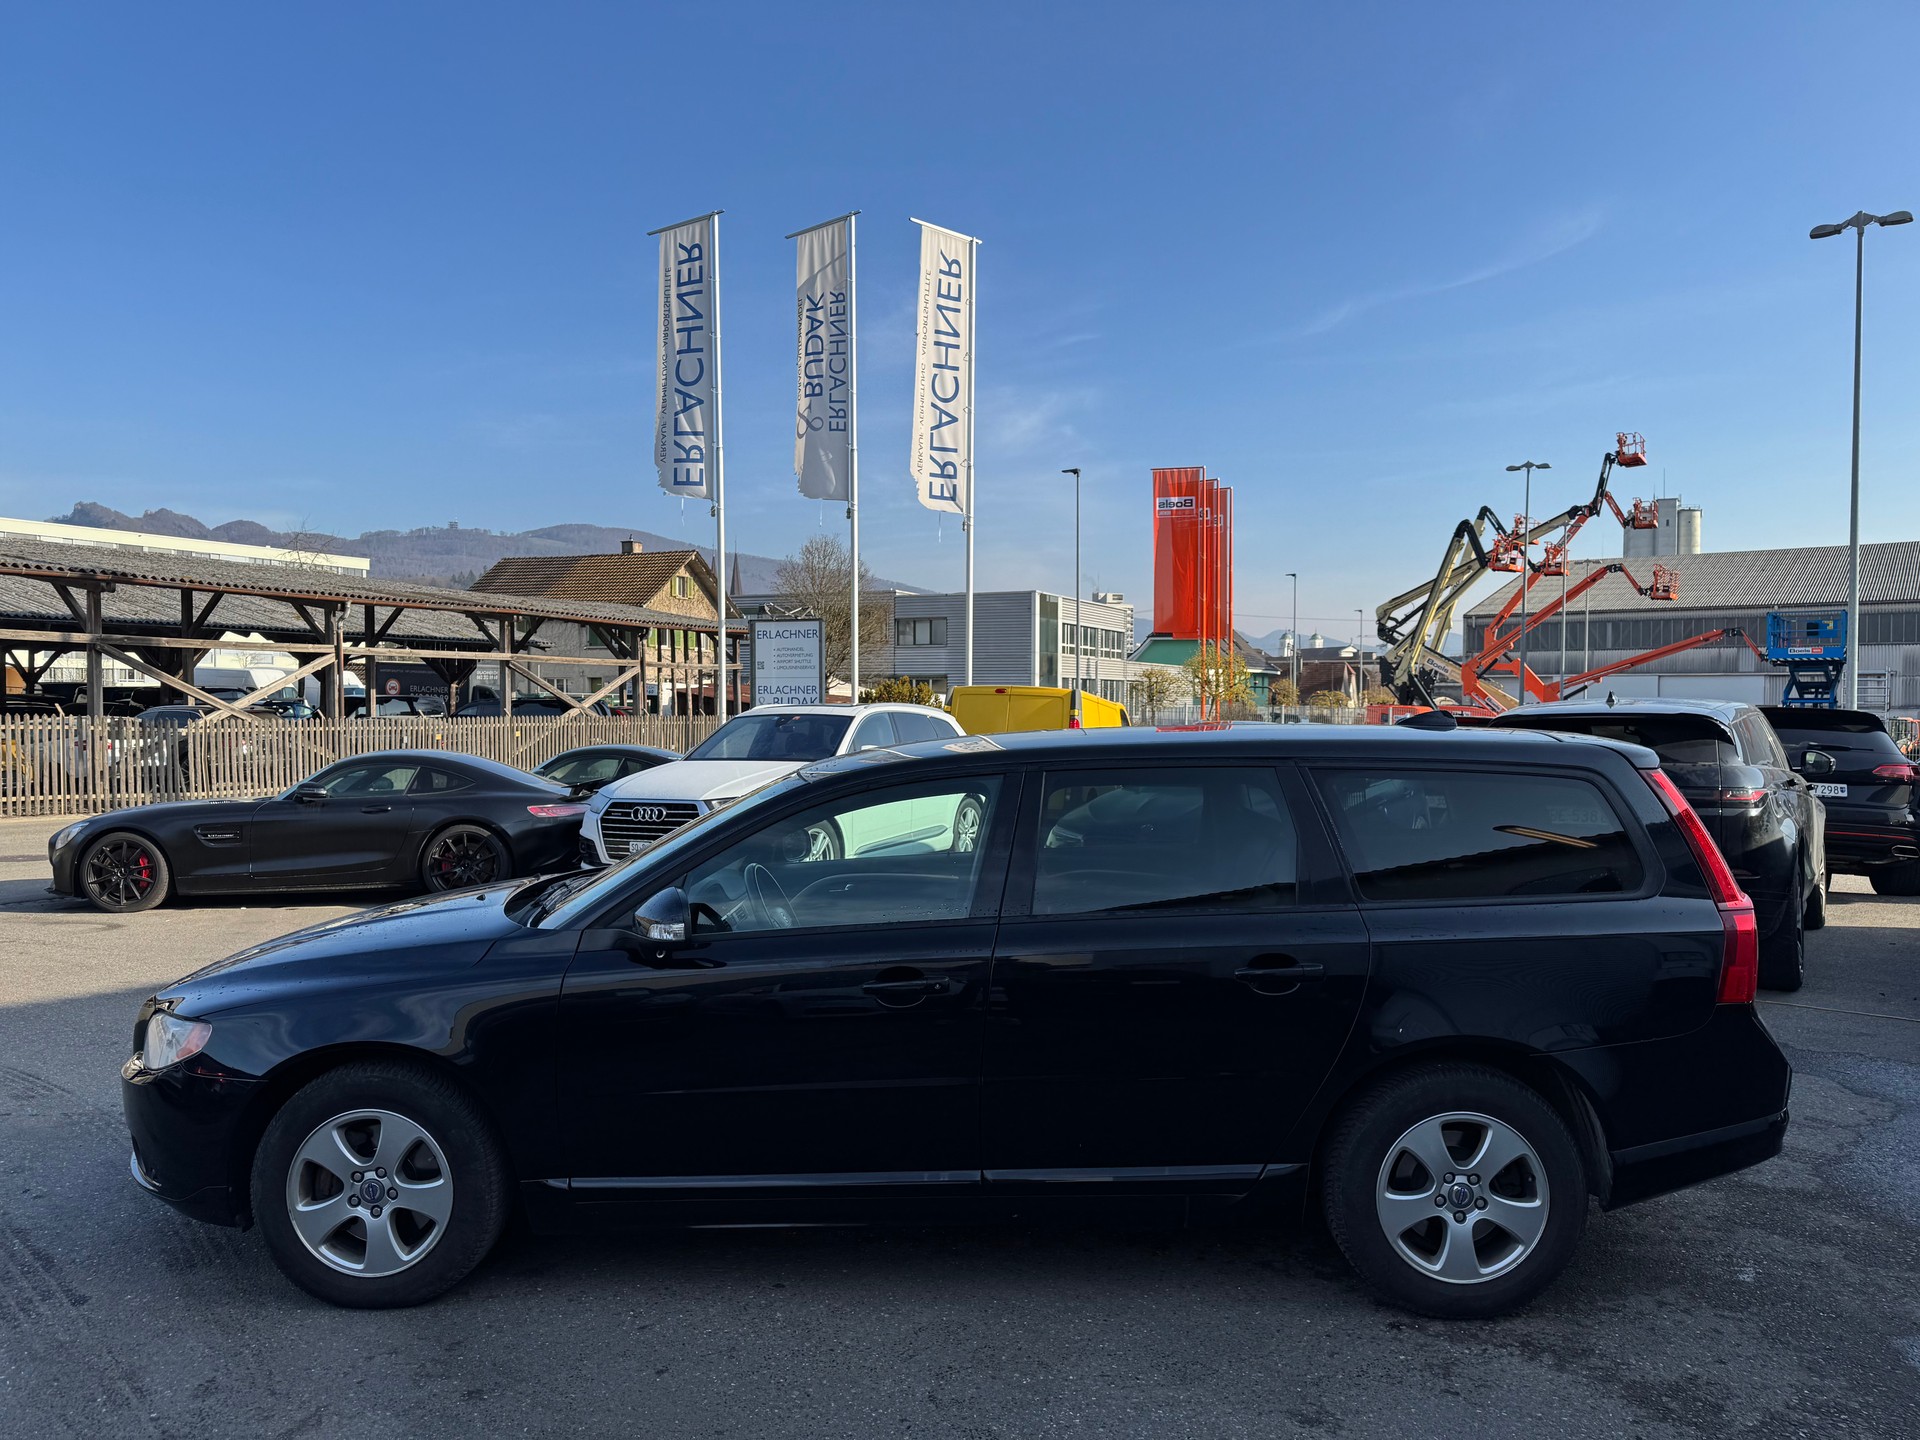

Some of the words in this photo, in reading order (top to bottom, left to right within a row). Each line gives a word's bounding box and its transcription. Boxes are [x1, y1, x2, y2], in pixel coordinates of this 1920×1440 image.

[756, 629, 819, 639] ERLACHNER
[758, 686, 817, 694] ERLACHNER
[1821, 785, 1839, 794] 298
